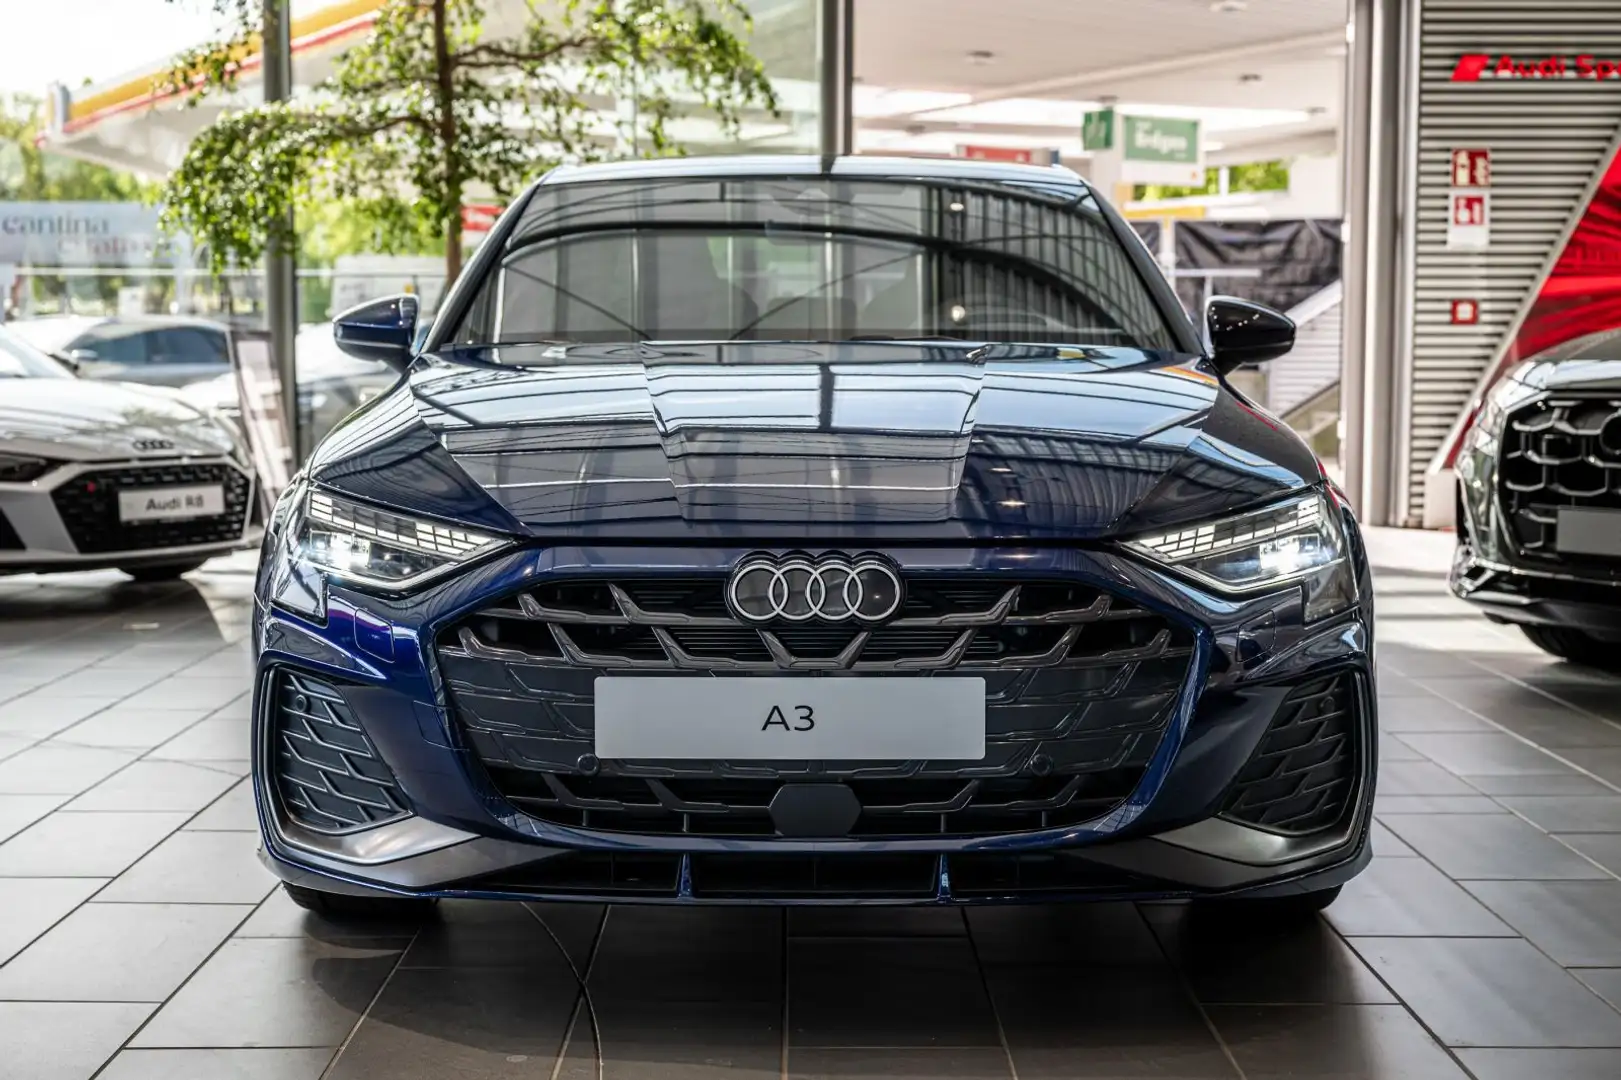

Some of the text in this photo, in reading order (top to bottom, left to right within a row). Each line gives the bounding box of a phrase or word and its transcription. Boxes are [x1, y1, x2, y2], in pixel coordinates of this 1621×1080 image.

[1495, 54, 1621, 81] Audi Sp
[145, 497, 182, 511] Audi
[761, 704, 815, 732] A3
